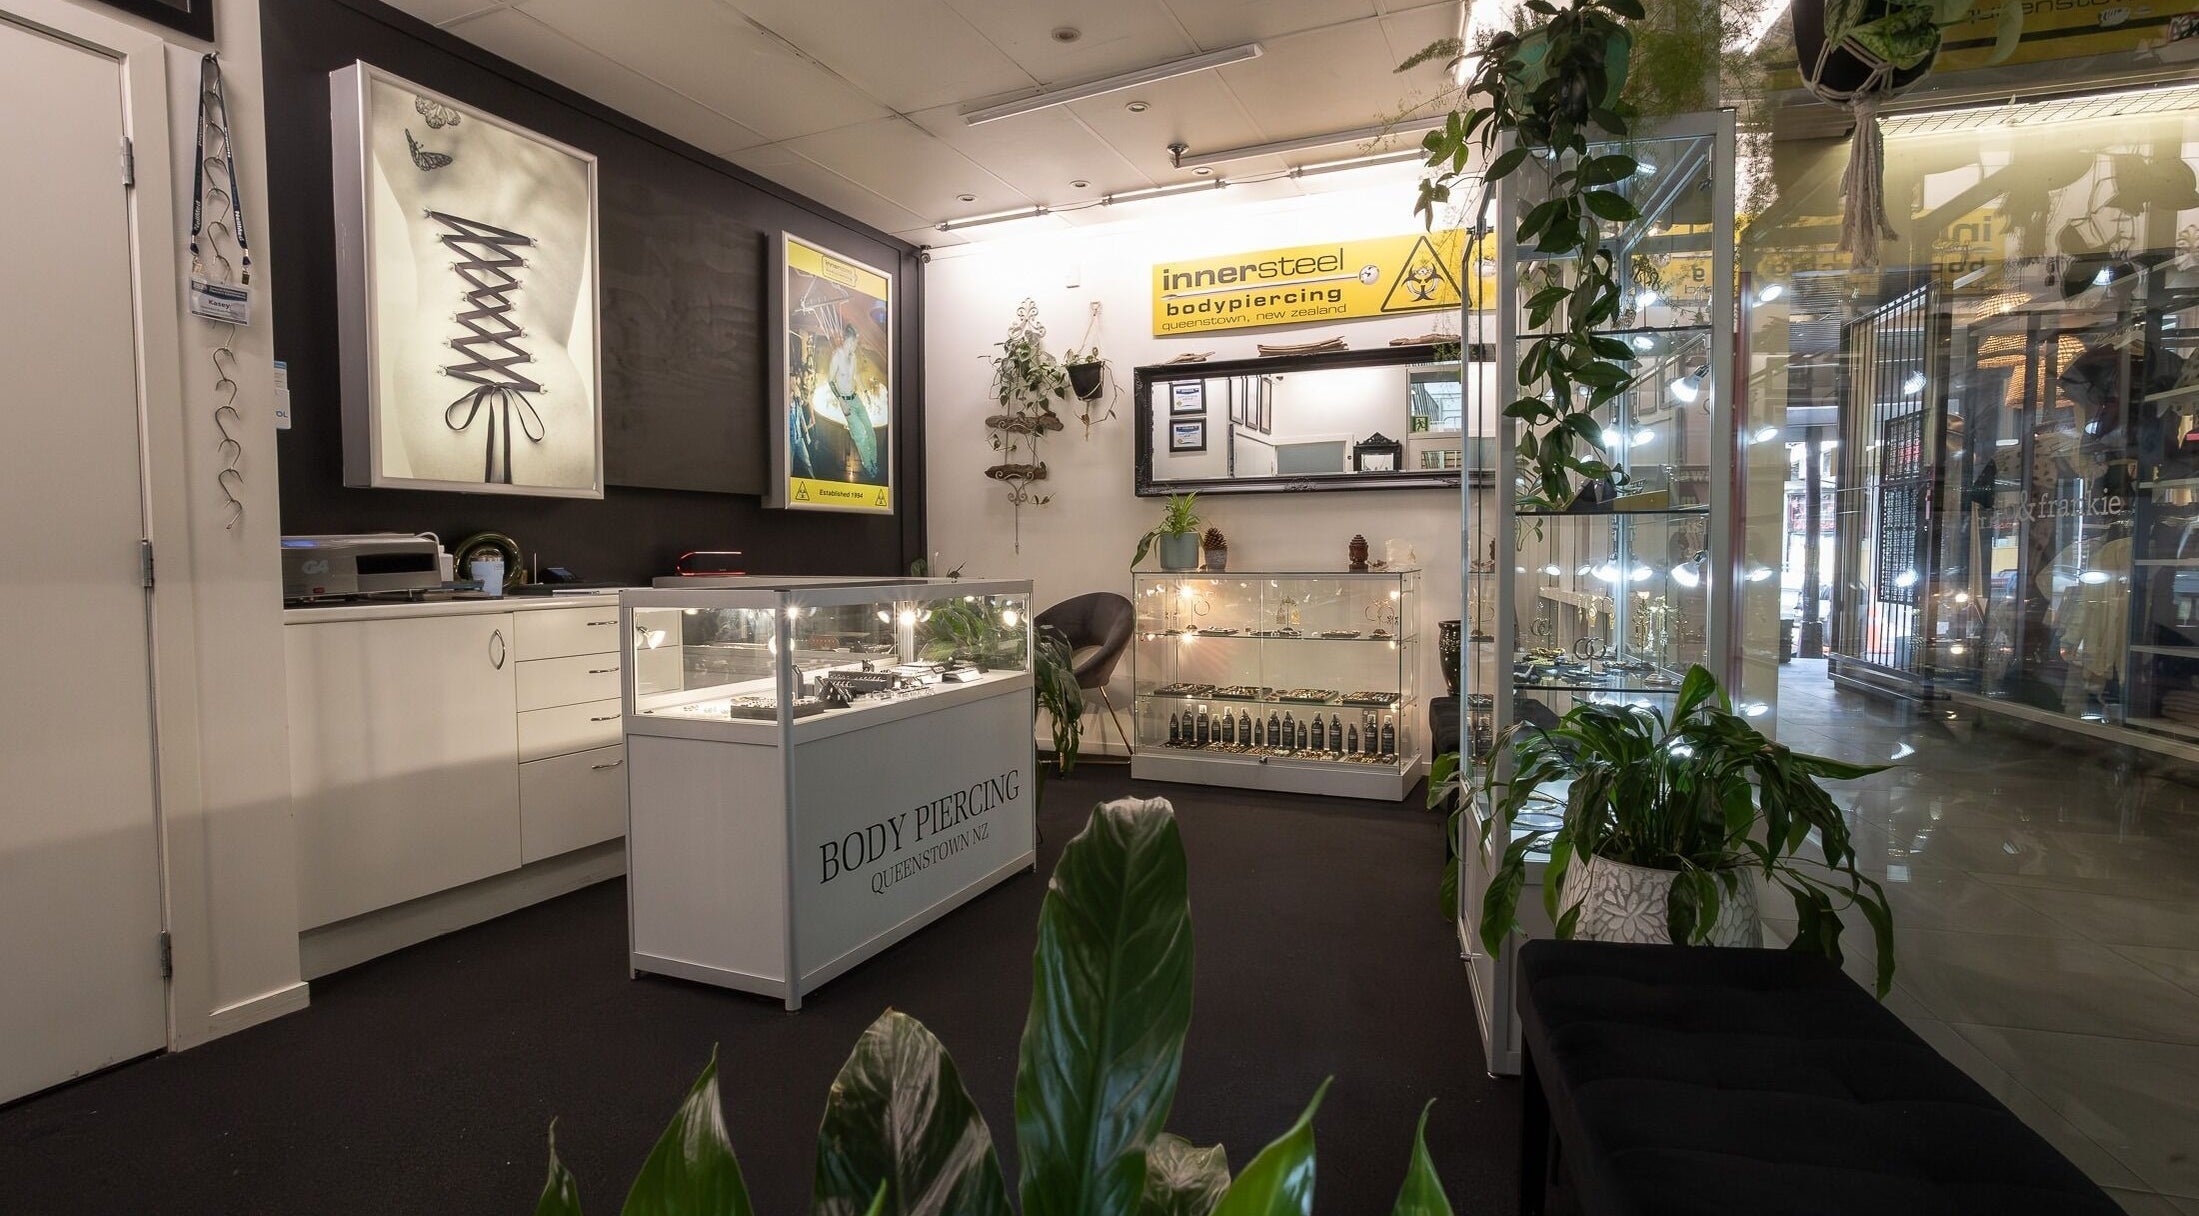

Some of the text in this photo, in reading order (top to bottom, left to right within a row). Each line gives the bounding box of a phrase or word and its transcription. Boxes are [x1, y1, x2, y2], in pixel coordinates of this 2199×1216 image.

[1162, 248, 1344, 291] innersteel
[1162, 303, 1347, 332] queenstown, new zealand
[1166, 288, 1342, 317] bodypiercing
[819, 489, 850, 498] Established
[819, 769, 1020, 885] BODY PIERCING
[871, 822, 990, 895] QUEENSTOWN NZ
